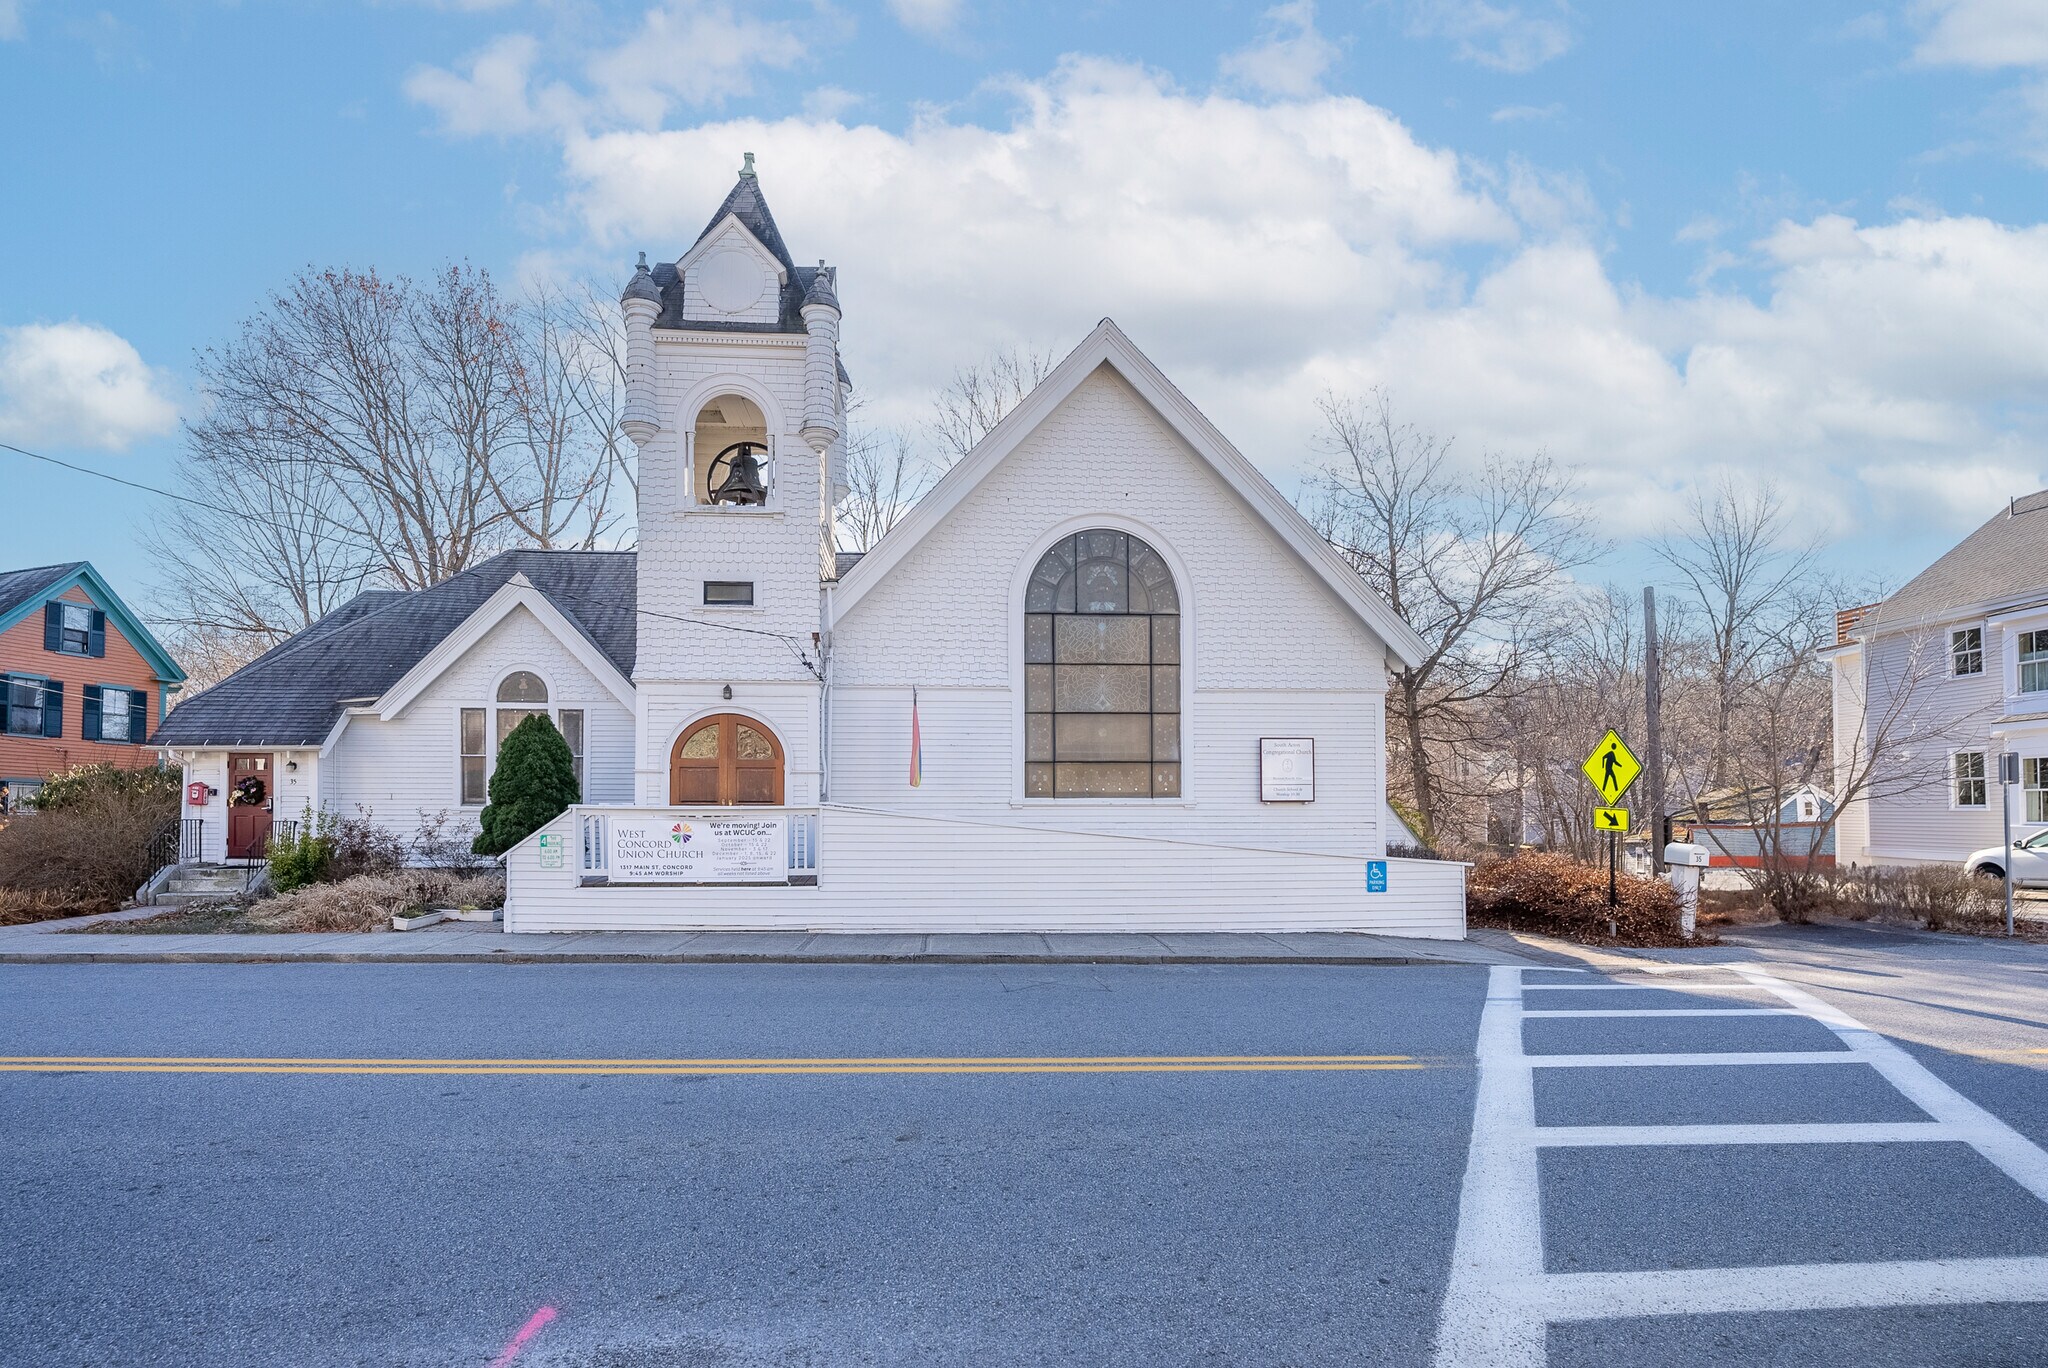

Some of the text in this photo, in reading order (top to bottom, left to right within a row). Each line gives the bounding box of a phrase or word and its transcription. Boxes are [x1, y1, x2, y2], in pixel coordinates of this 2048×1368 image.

[732, 822, 760, 830] moving!
[617, 829, 646, 838] WEST
[617, 840, 672, 848] CONCORD
[617, 849, 704, 859] UNION CHURCH
